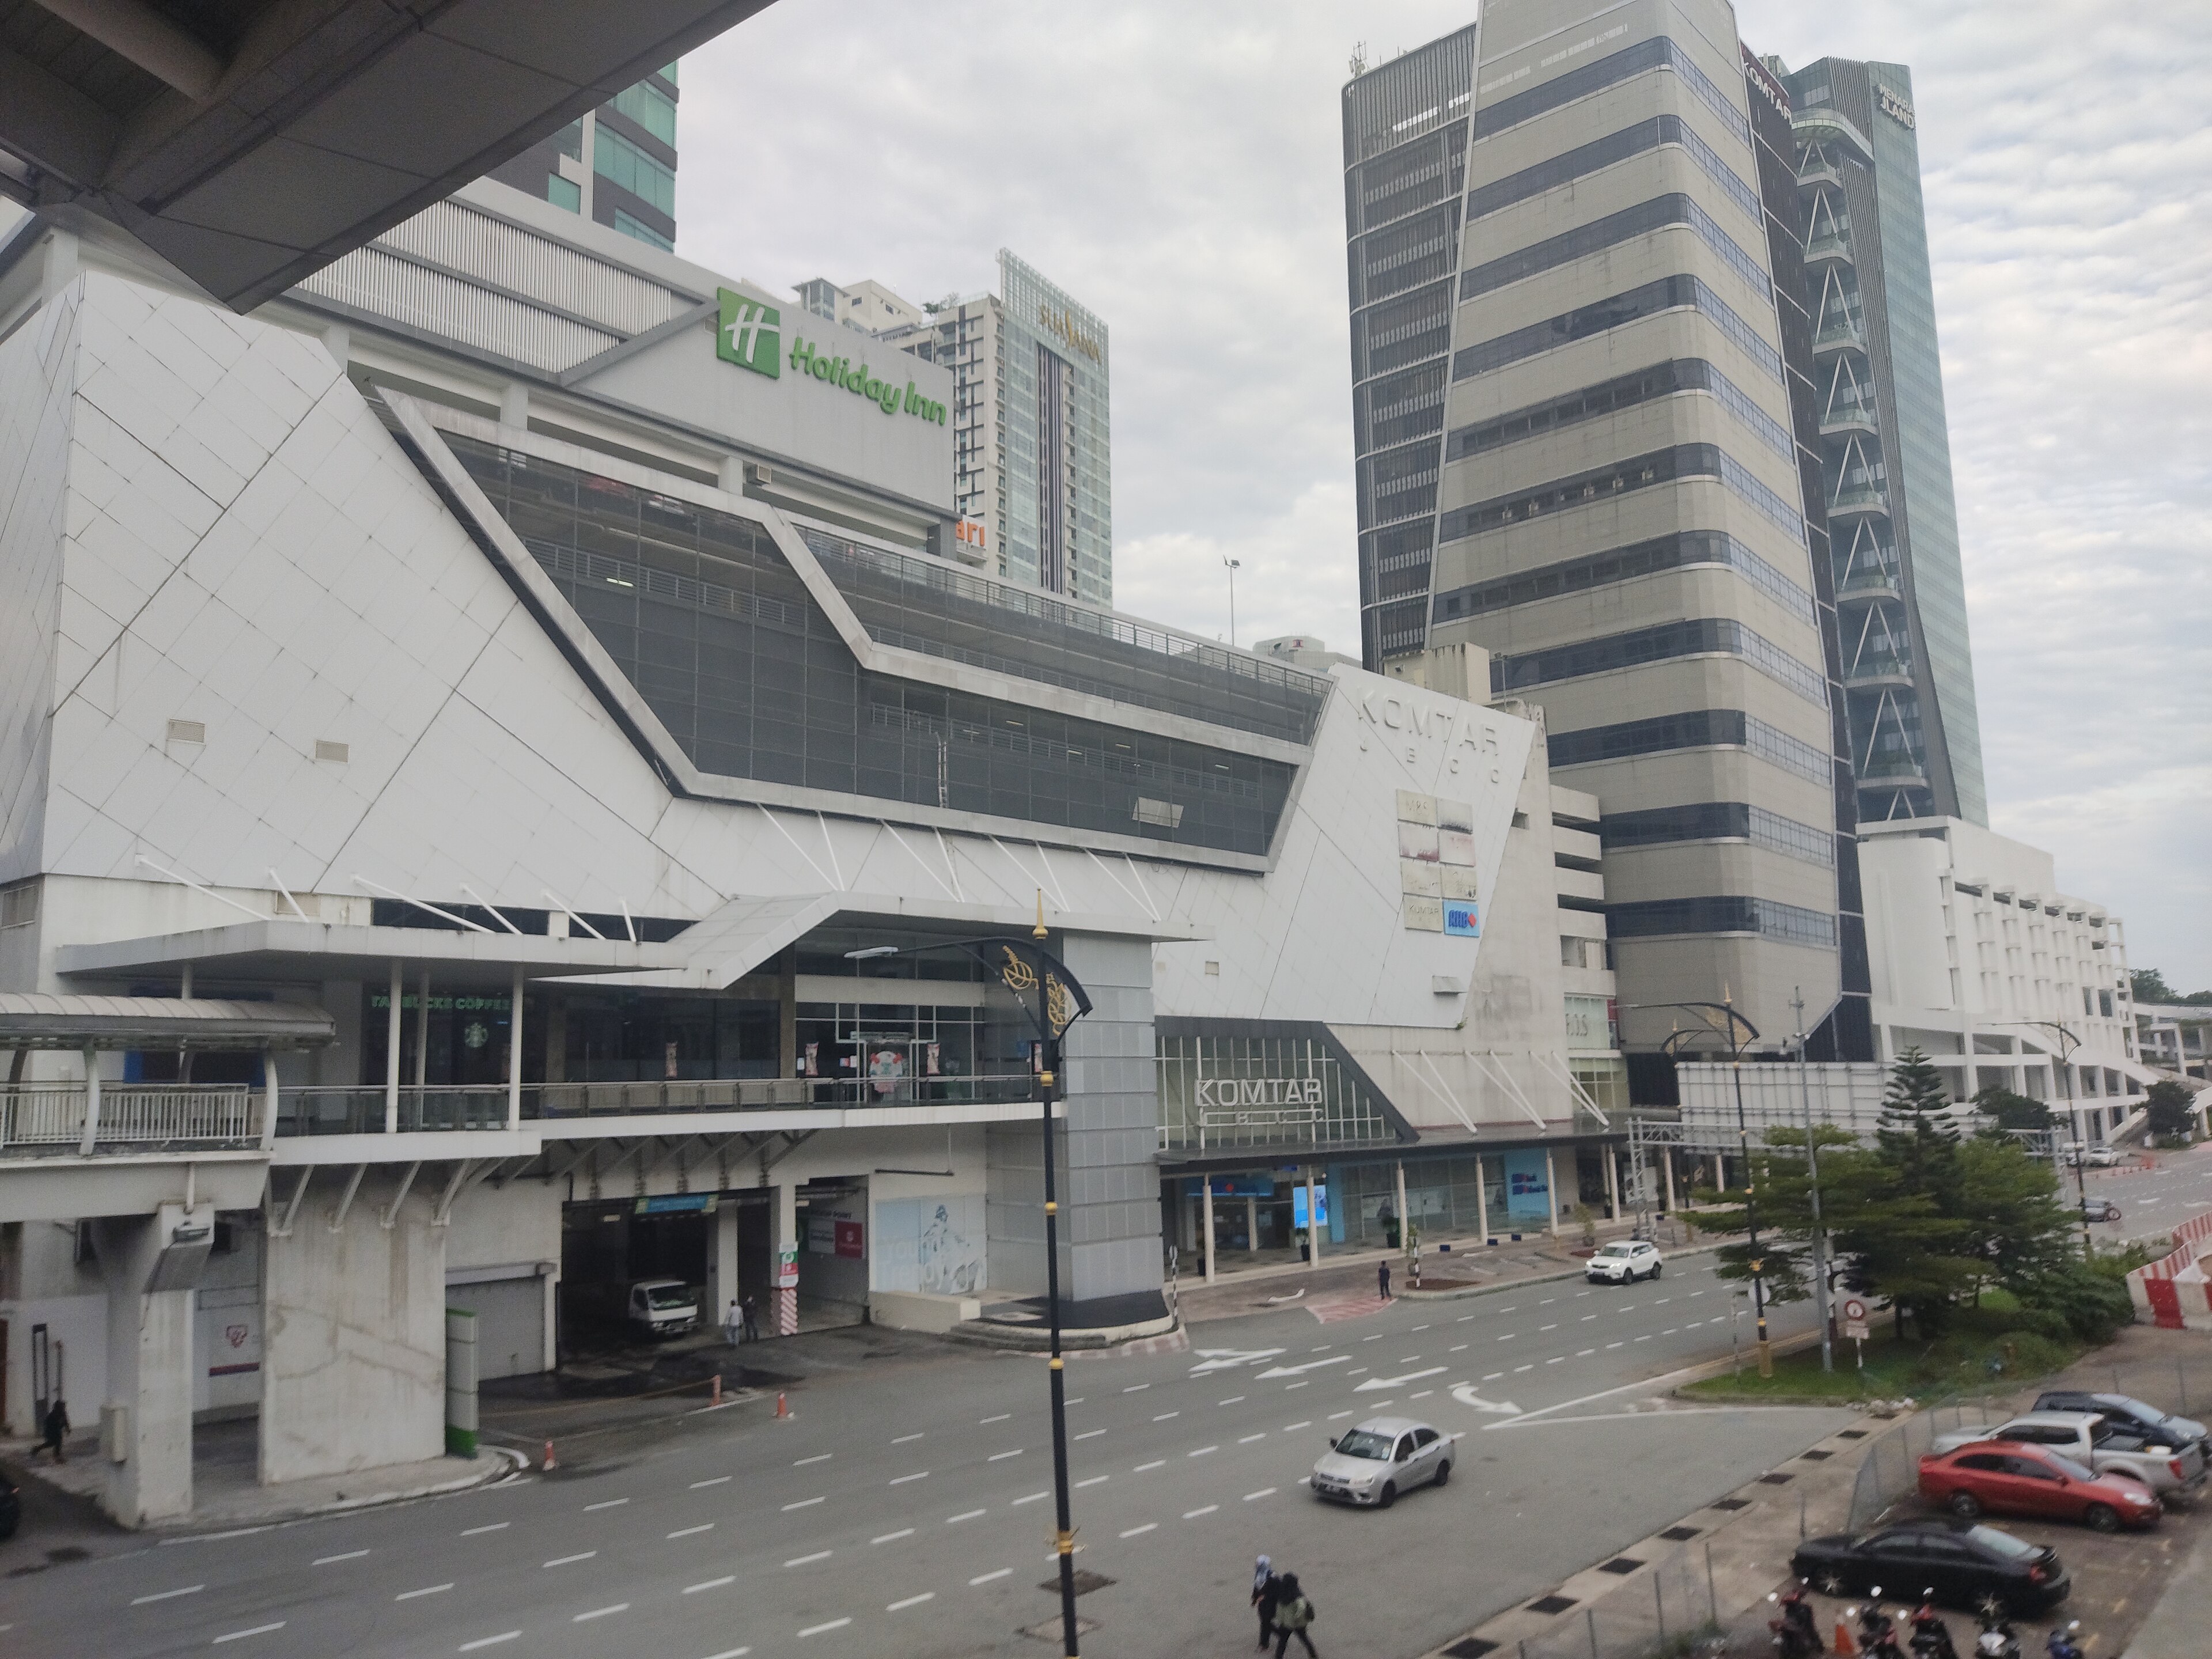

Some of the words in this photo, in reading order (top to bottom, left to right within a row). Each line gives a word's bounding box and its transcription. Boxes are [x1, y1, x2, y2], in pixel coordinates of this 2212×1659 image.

[1744, 62, 1792, 126] KOMTAR
[1879, 83, 1915, 115] MENARA
[1880, 96, 1915, 128] JLAND
[789, 336, 902, 415] Holiday
[904, 380, 947, 426] Inn
[1357, 687, 1500, 756] KOMTAR
[455, 997, 511, 1010] COFFEE
[1195, 1078, 1323, 1107] KOMTAR
